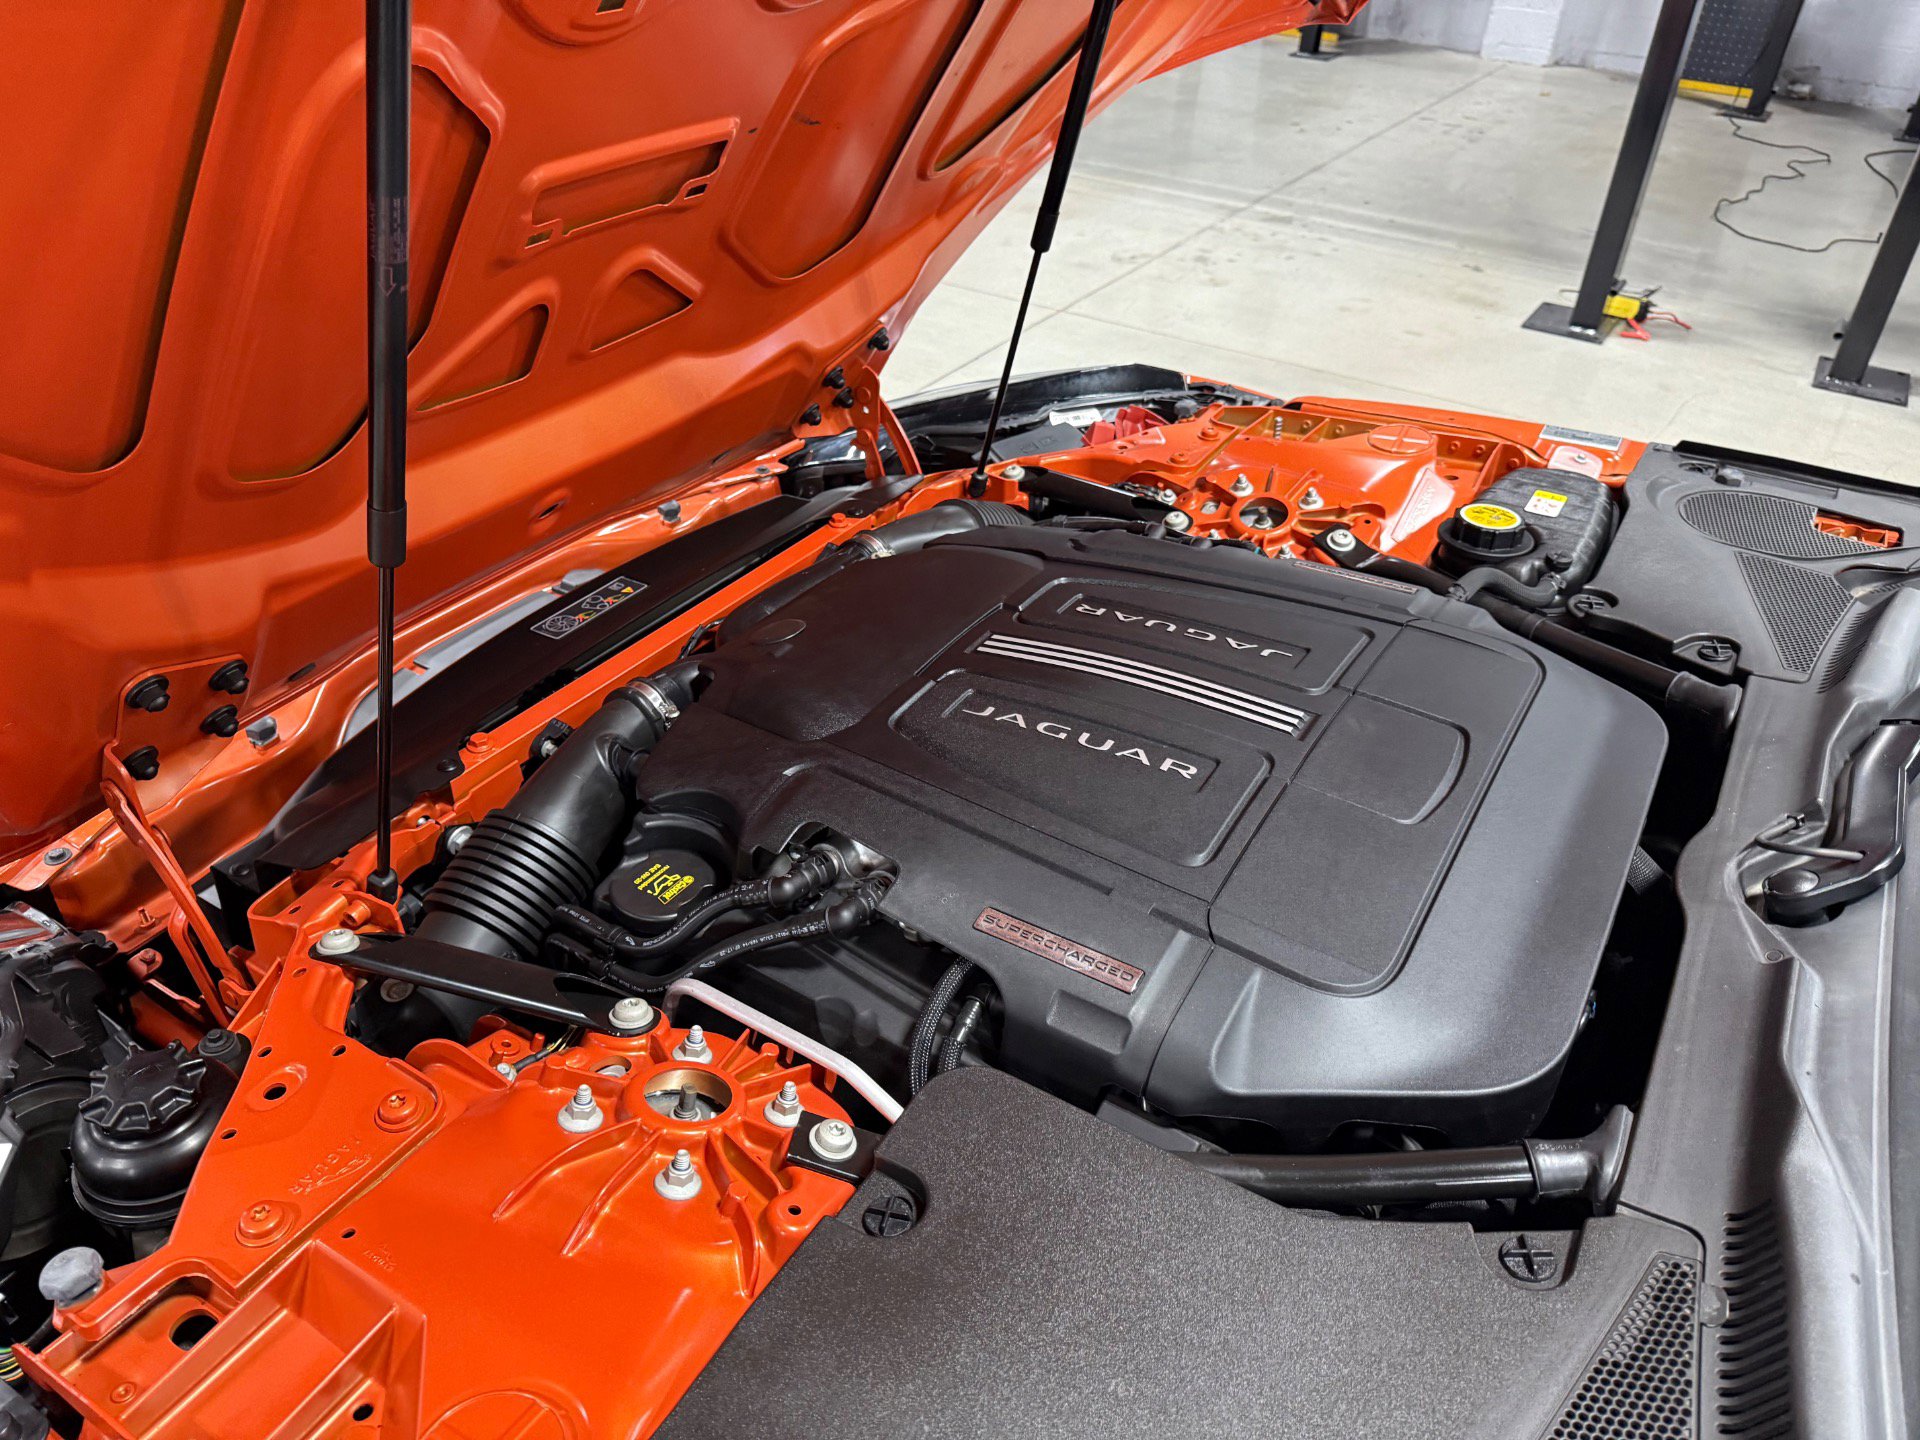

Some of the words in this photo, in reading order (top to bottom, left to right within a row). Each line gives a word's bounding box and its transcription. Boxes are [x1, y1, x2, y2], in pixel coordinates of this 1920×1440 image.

[1075, 603, 1293, 657] JAGUAR
[962, 706, 1198, 780] JAGUAR
[982, 913, 1135, 982] SUPERCHARGED
[288, 1137, 361, 1195] JAGUAR
